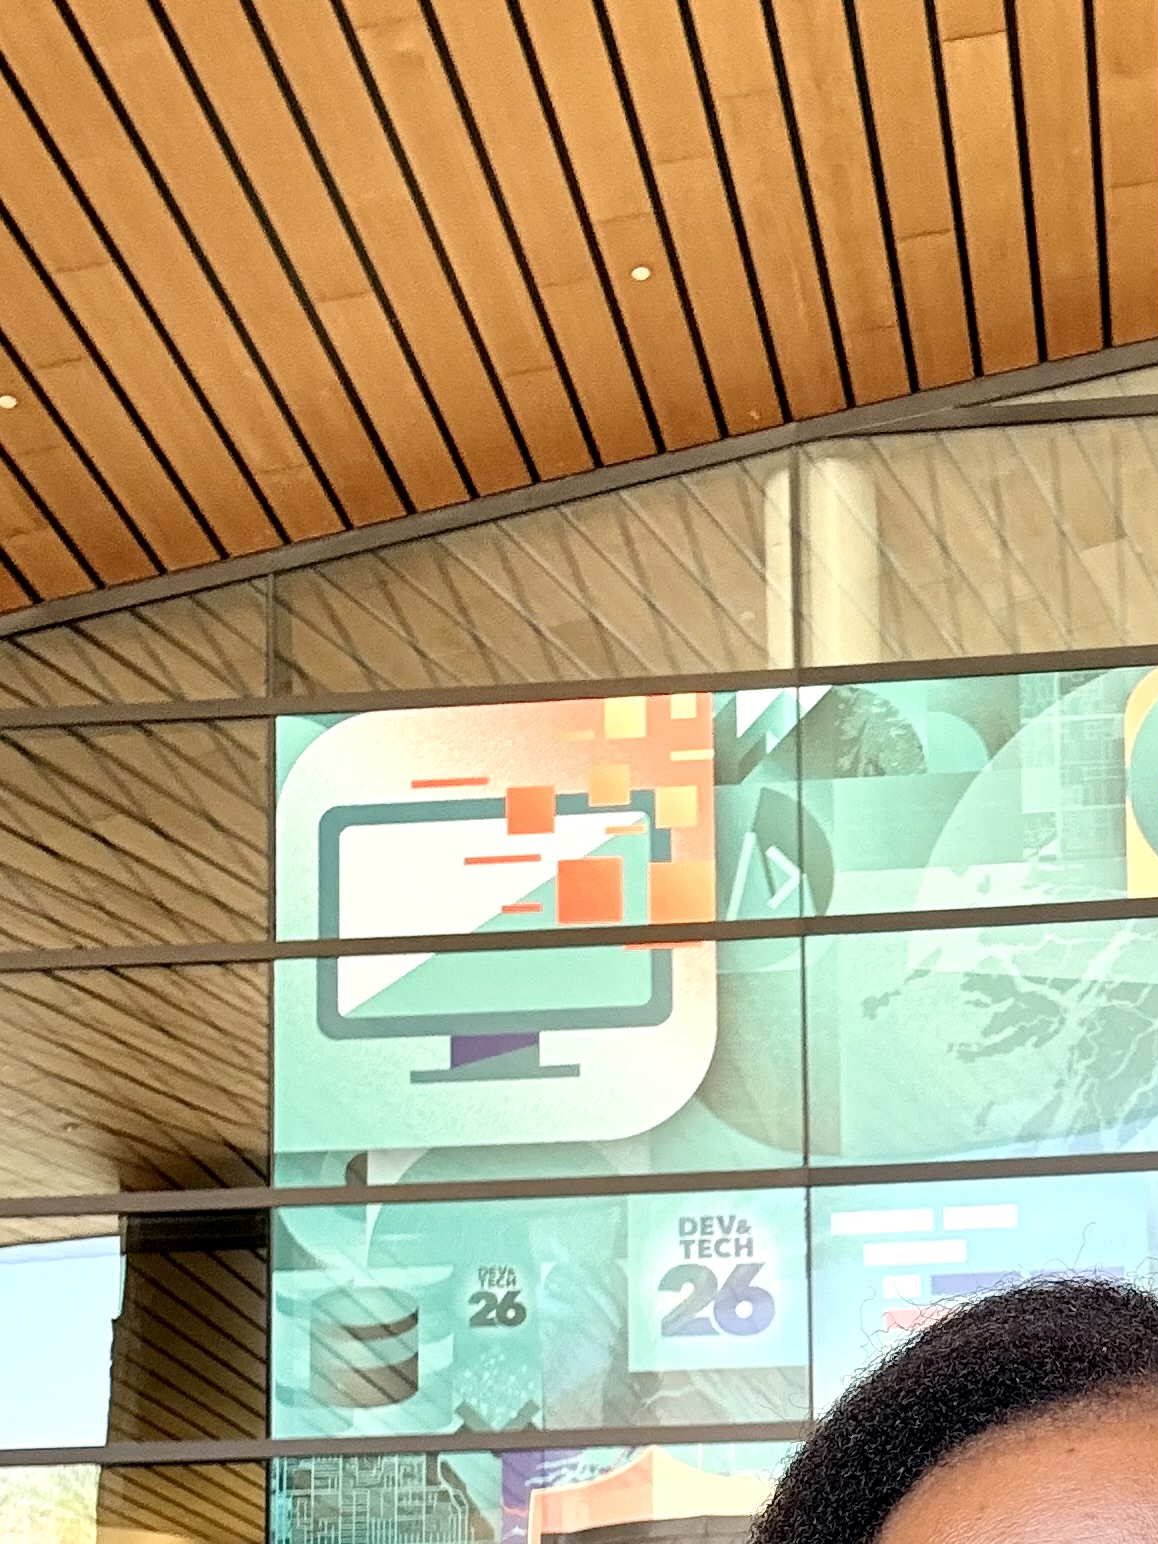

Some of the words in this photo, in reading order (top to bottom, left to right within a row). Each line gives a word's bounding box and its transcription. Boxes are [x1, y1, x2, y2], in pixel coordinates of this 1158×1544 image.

[678, 1214, 752, 1237] DEV&
[678, 1237, 754, 1259] TECH
[468, 1289, 527, 1328] 26
[658, 1263, 776, 1337] 26
